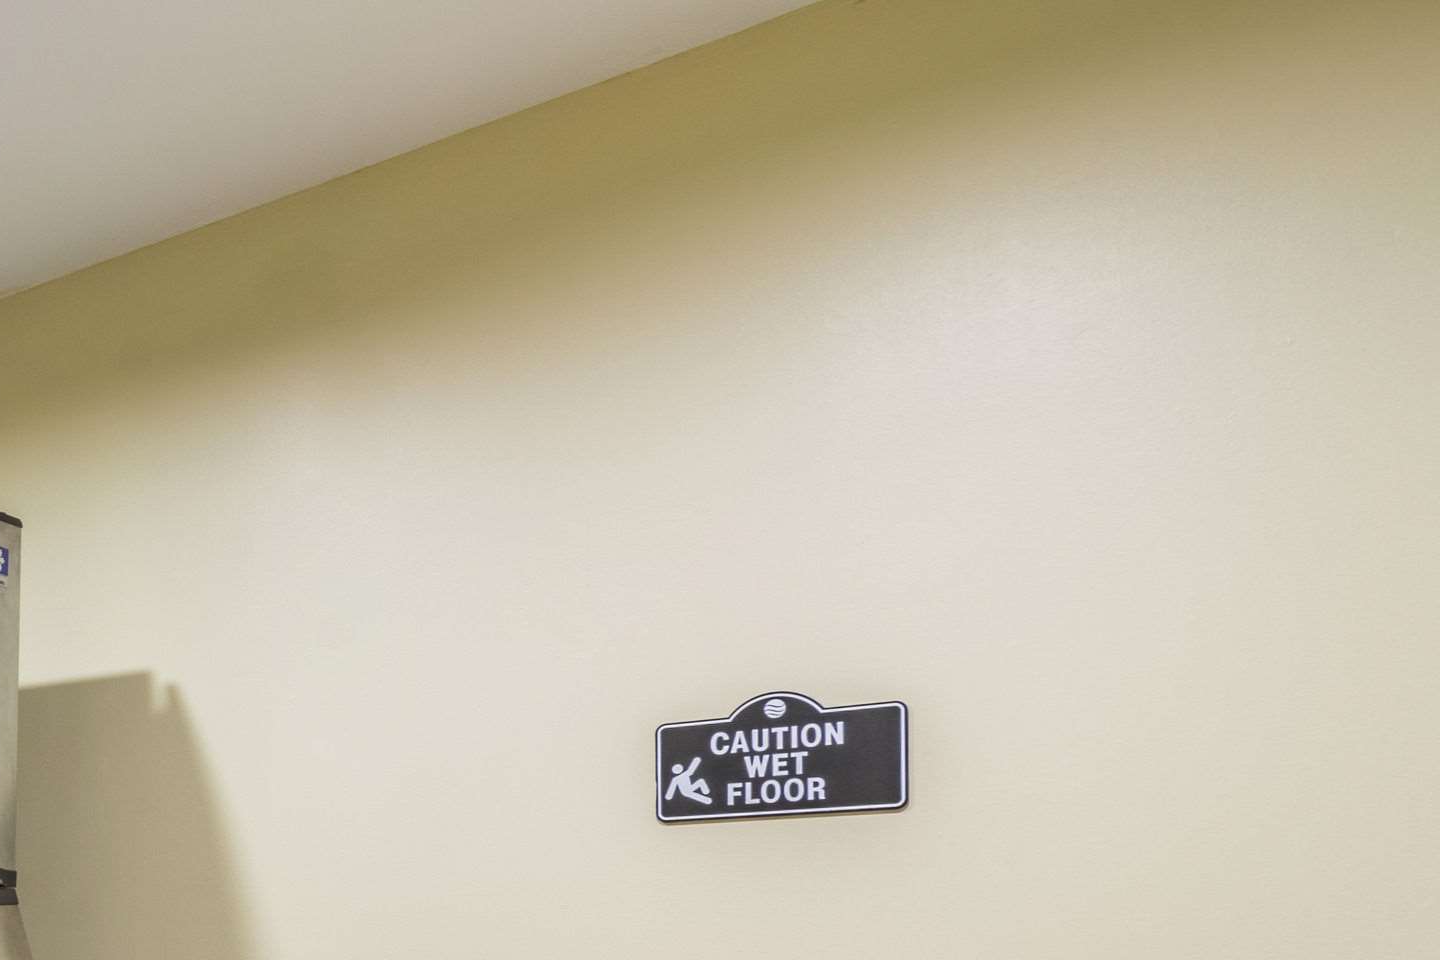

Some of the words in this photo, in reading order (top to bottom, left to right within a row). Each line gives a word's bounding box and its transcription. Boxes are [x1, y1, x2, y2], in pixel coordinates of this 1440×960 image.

[710, 721, 845, 755] CAUTION
[744, 751, 809, 778] WET
[727, 777, 826, 806] FLOOR
